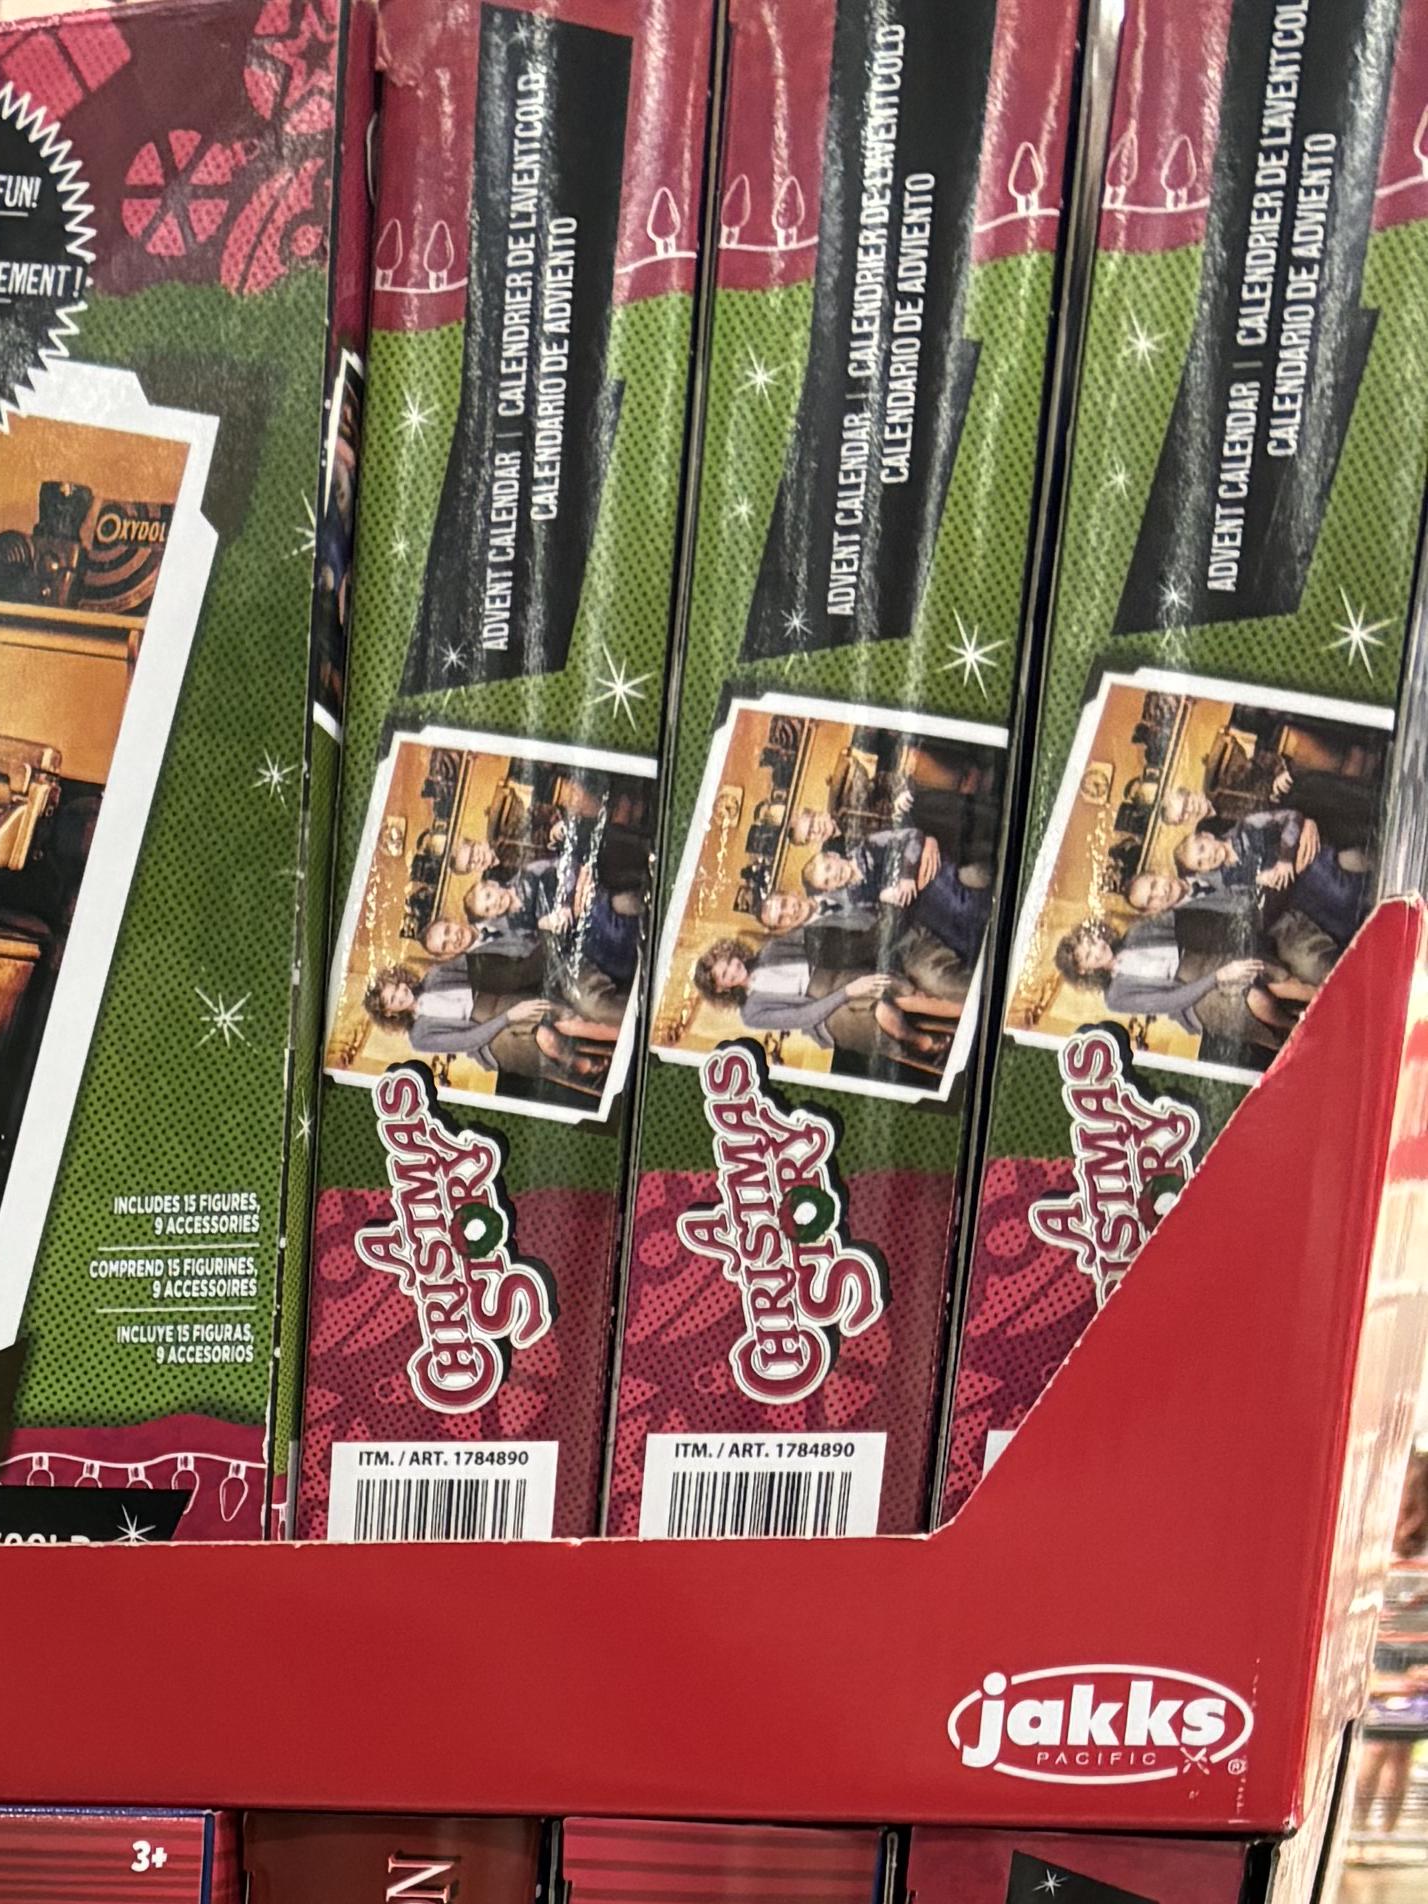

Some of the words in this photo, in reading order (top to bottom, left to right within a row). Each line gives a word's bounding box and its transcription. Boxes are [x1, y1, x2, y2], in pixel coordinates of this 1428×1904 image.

[114, 1195, 180, 1214] INCLUDES
[184, 1194, 196, 1212] 15
[199, 1192, 260, 1213] FIGURES,
[155, 1217, 163, 1235] 9
[166, 1214, 260, 1234] ACCESSORIES
[426, 1117, 549, 1345] STORY
[379, 1077, 496, 1405] CHRISTMAS
[89, 1259, 164, 1278] COMPREND
[168, 1258, 180, 1276] 15
[183, 1257, 258, 1276] FIGURINES,
[359, 1230, 418, 1291] A
[153, 1280, 161, 1298] 9
[164, 1279, 257, 1298] ACCESSOIRES
[358, 1451, 394, 1466] ITM.
[406, 1451, 448, 1467] ART.
[454, 1450, 529, 1466] 1784890
[962, 1672, 1226, 1768] jakks
[131, 1840, 168, 1873] 3+
